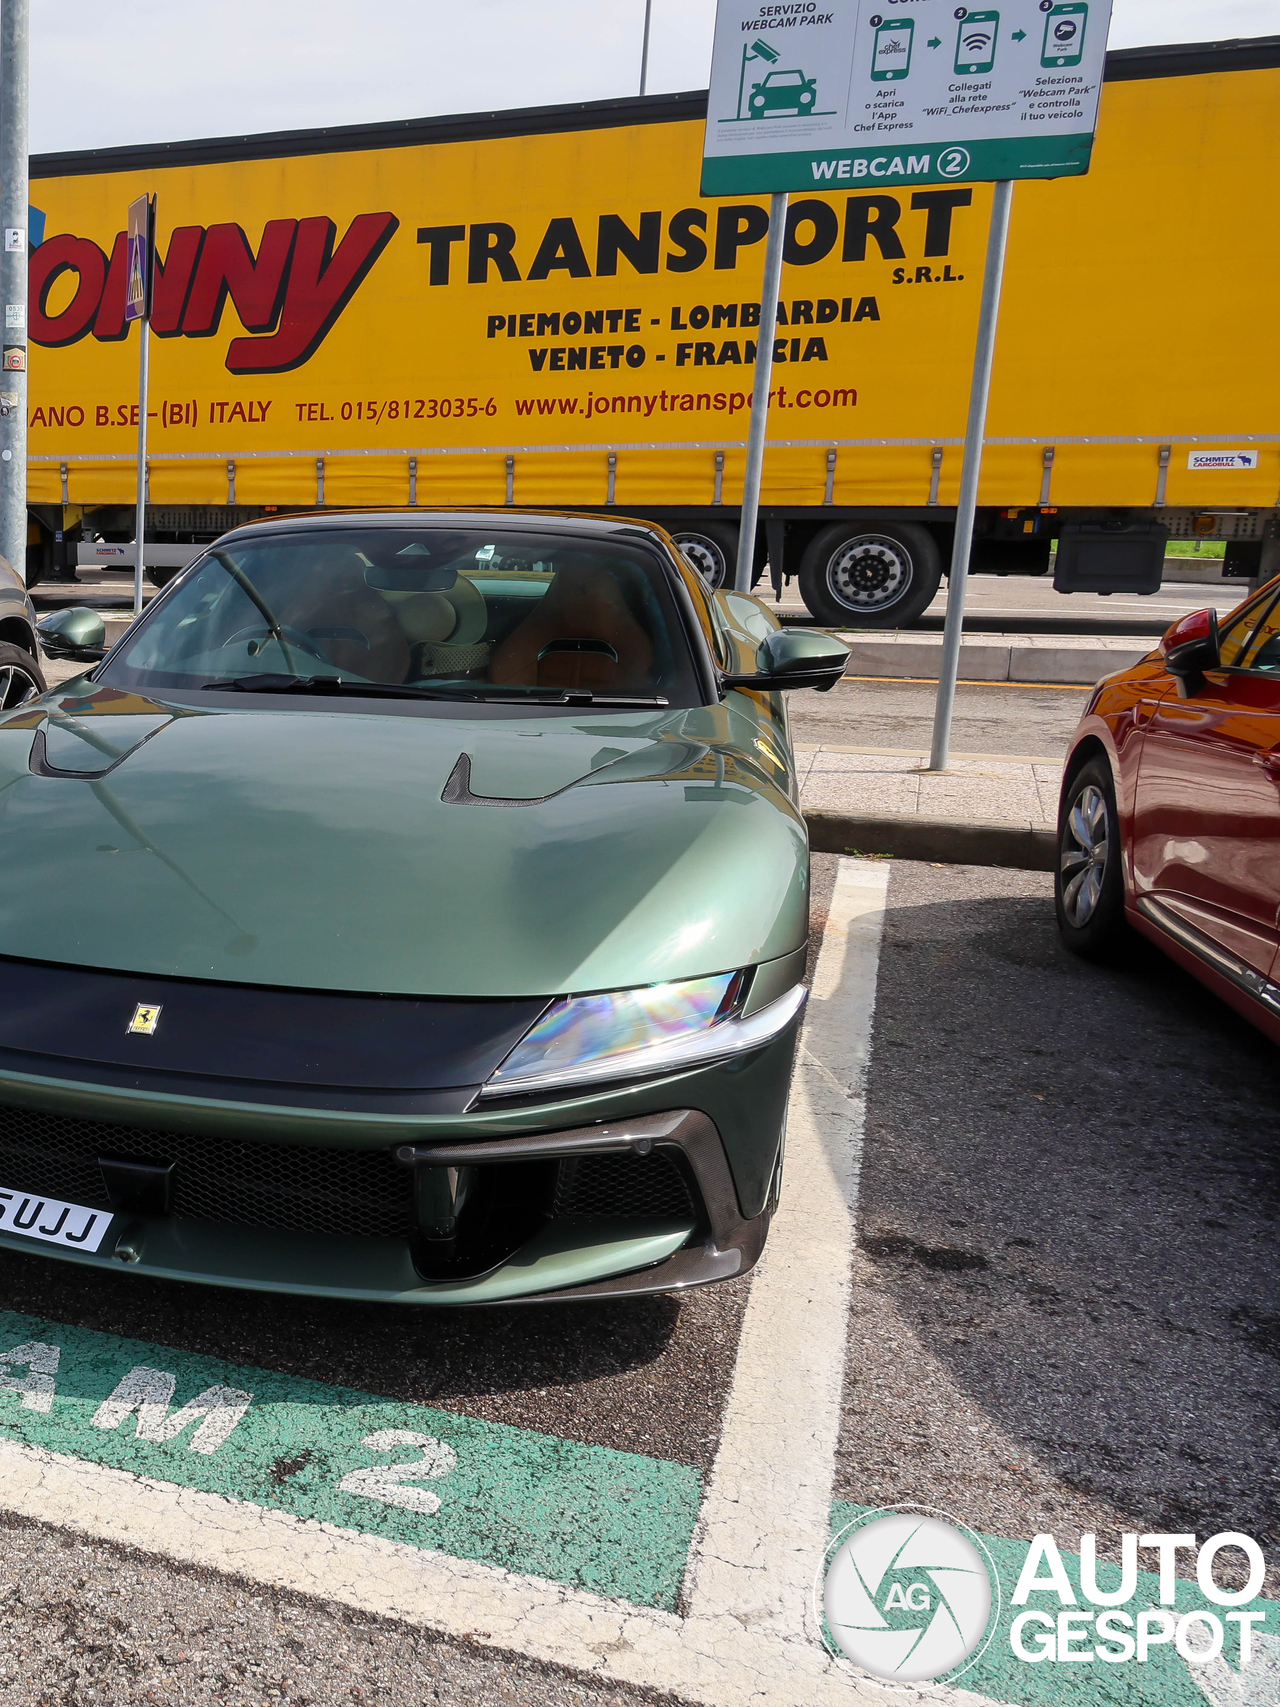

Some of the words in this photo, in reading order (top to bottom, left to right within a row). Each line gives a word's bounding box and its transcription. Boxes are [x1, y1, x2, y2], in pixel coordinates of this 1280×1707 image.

[759, 2, 816, 17] SERVIZIO
[957, 9, 964, 17] 2
[741, 16, 796, 31] WEBCAM
[800, 13, 834, 26] PARK
[948, 81, 992, 93] Collegati
[1035, 76, 1083, 86] Seleziona
[876, 89, 896, 99] Apri
[949, 95, 967, 104] alla
[968, 94, 987, 102] rete
[873, 100, 904, 109] scarica
[1037, 99, 1081, 109] controlla
[872, 112, 897, 122] l'App
[1020, 112, 1027, 121] il
[1029, 113, 1045, 121] tuo
[1048, 110, 1083, 119] veicolo
[853, 123, 876, 132] Chef
[877, 121, 913, 132] Express
[811, 155, 930, 179] WEBCAM
[945, 151, 961, 172] 2
[416, 188, 973, 286] TRANSPORT
[892, 264, 965, 284] S.R.L.
[487, 308, 642, 338] PIEMONTE
[528, 344, 645, 371] VENETO
[675, 337, 828, 366] FRANCIA
[209, 400, 273, 424] ITALY
[296, 403, 335, 422] TEL.
[341, 397, 498, 425] 015/8123035-6
[335, 1427, 459, 1515] 2
